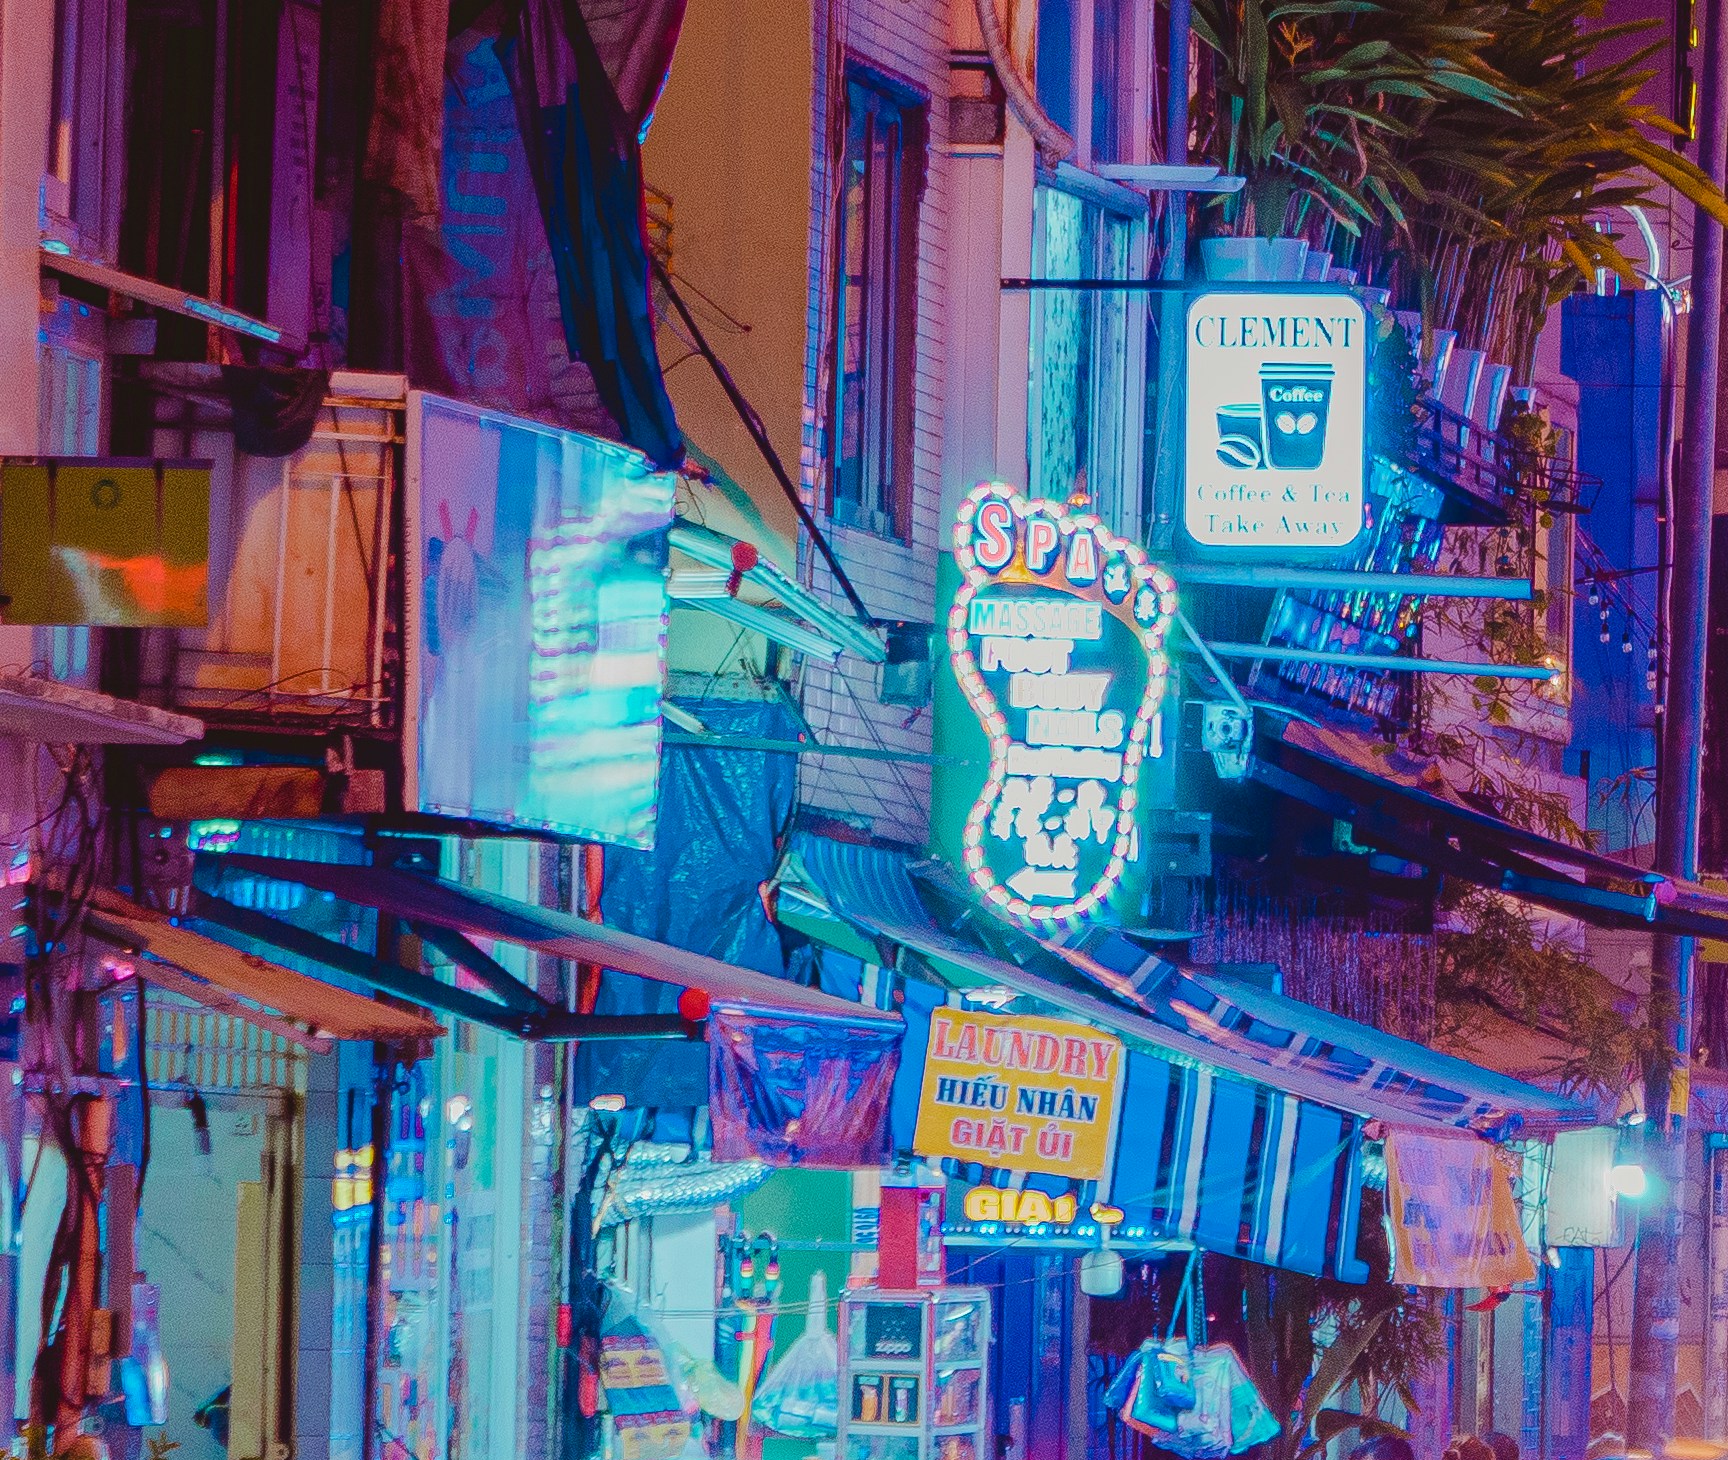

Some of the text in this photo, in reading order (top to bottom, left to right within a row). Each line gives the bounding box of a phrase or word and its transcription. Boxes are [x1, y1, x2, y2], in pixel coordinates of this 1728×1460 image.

[1195, 316, 1356, 348] CLEMENT
[1270, 386, 1324, 402] Coffee
[1198, 484, 1350, 502] Coffee & Tea
[975, 501, 1098, 580] SPA
[1205, 515, 1343, 535] Take Away
[974, 602, 1098, 635] MASSAGE
[933, 1018, 1116, 1081] LAUNDRY
[936, 1075, 1098, 1122] HIẾU NHÂN
[951, 1117, 1073, 1162] GIẶT ỦI
